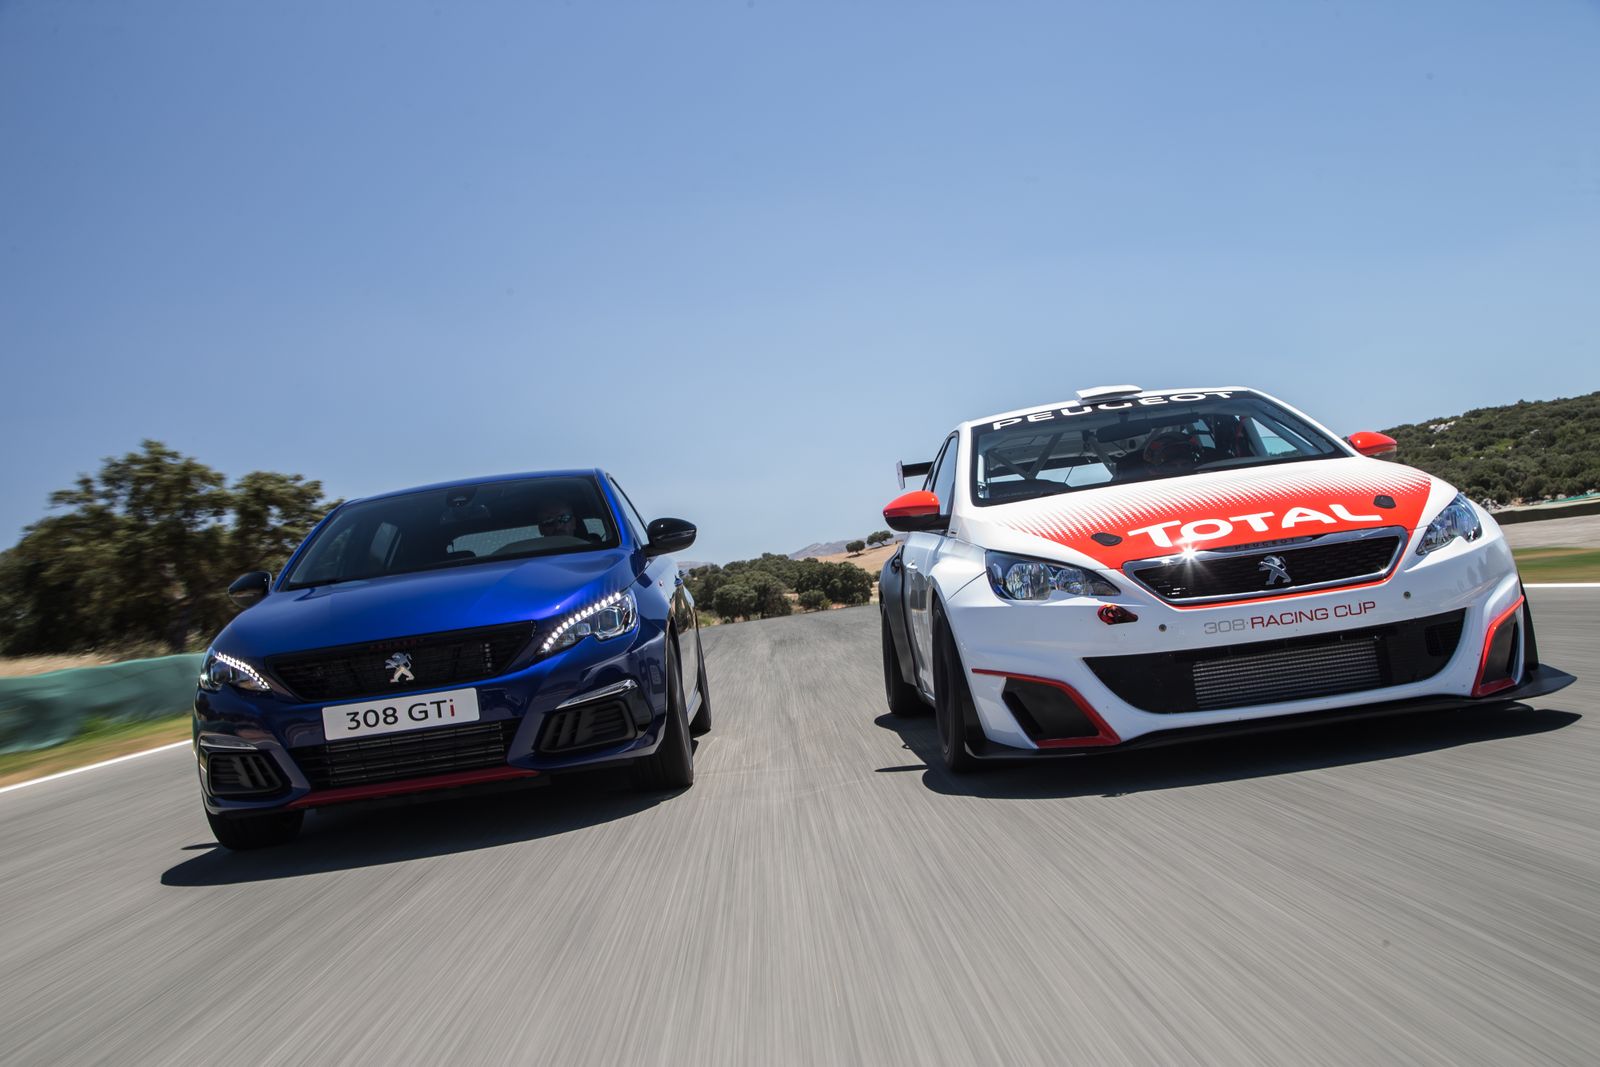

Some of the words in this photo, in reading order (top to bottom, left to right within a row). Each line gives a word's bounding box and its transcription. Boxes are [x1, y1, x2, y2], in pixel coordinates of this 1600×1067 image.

[993, 391, 1233, 430] PEUGEOT
[1127, 503, 1383, 548] TOTAL
[1250, 607, 1329, 629] RACING
[1333, 601, 1376, 618] CUP
[346, 706, 399, 730] 308
[407, 699, 455, 722] GTi
